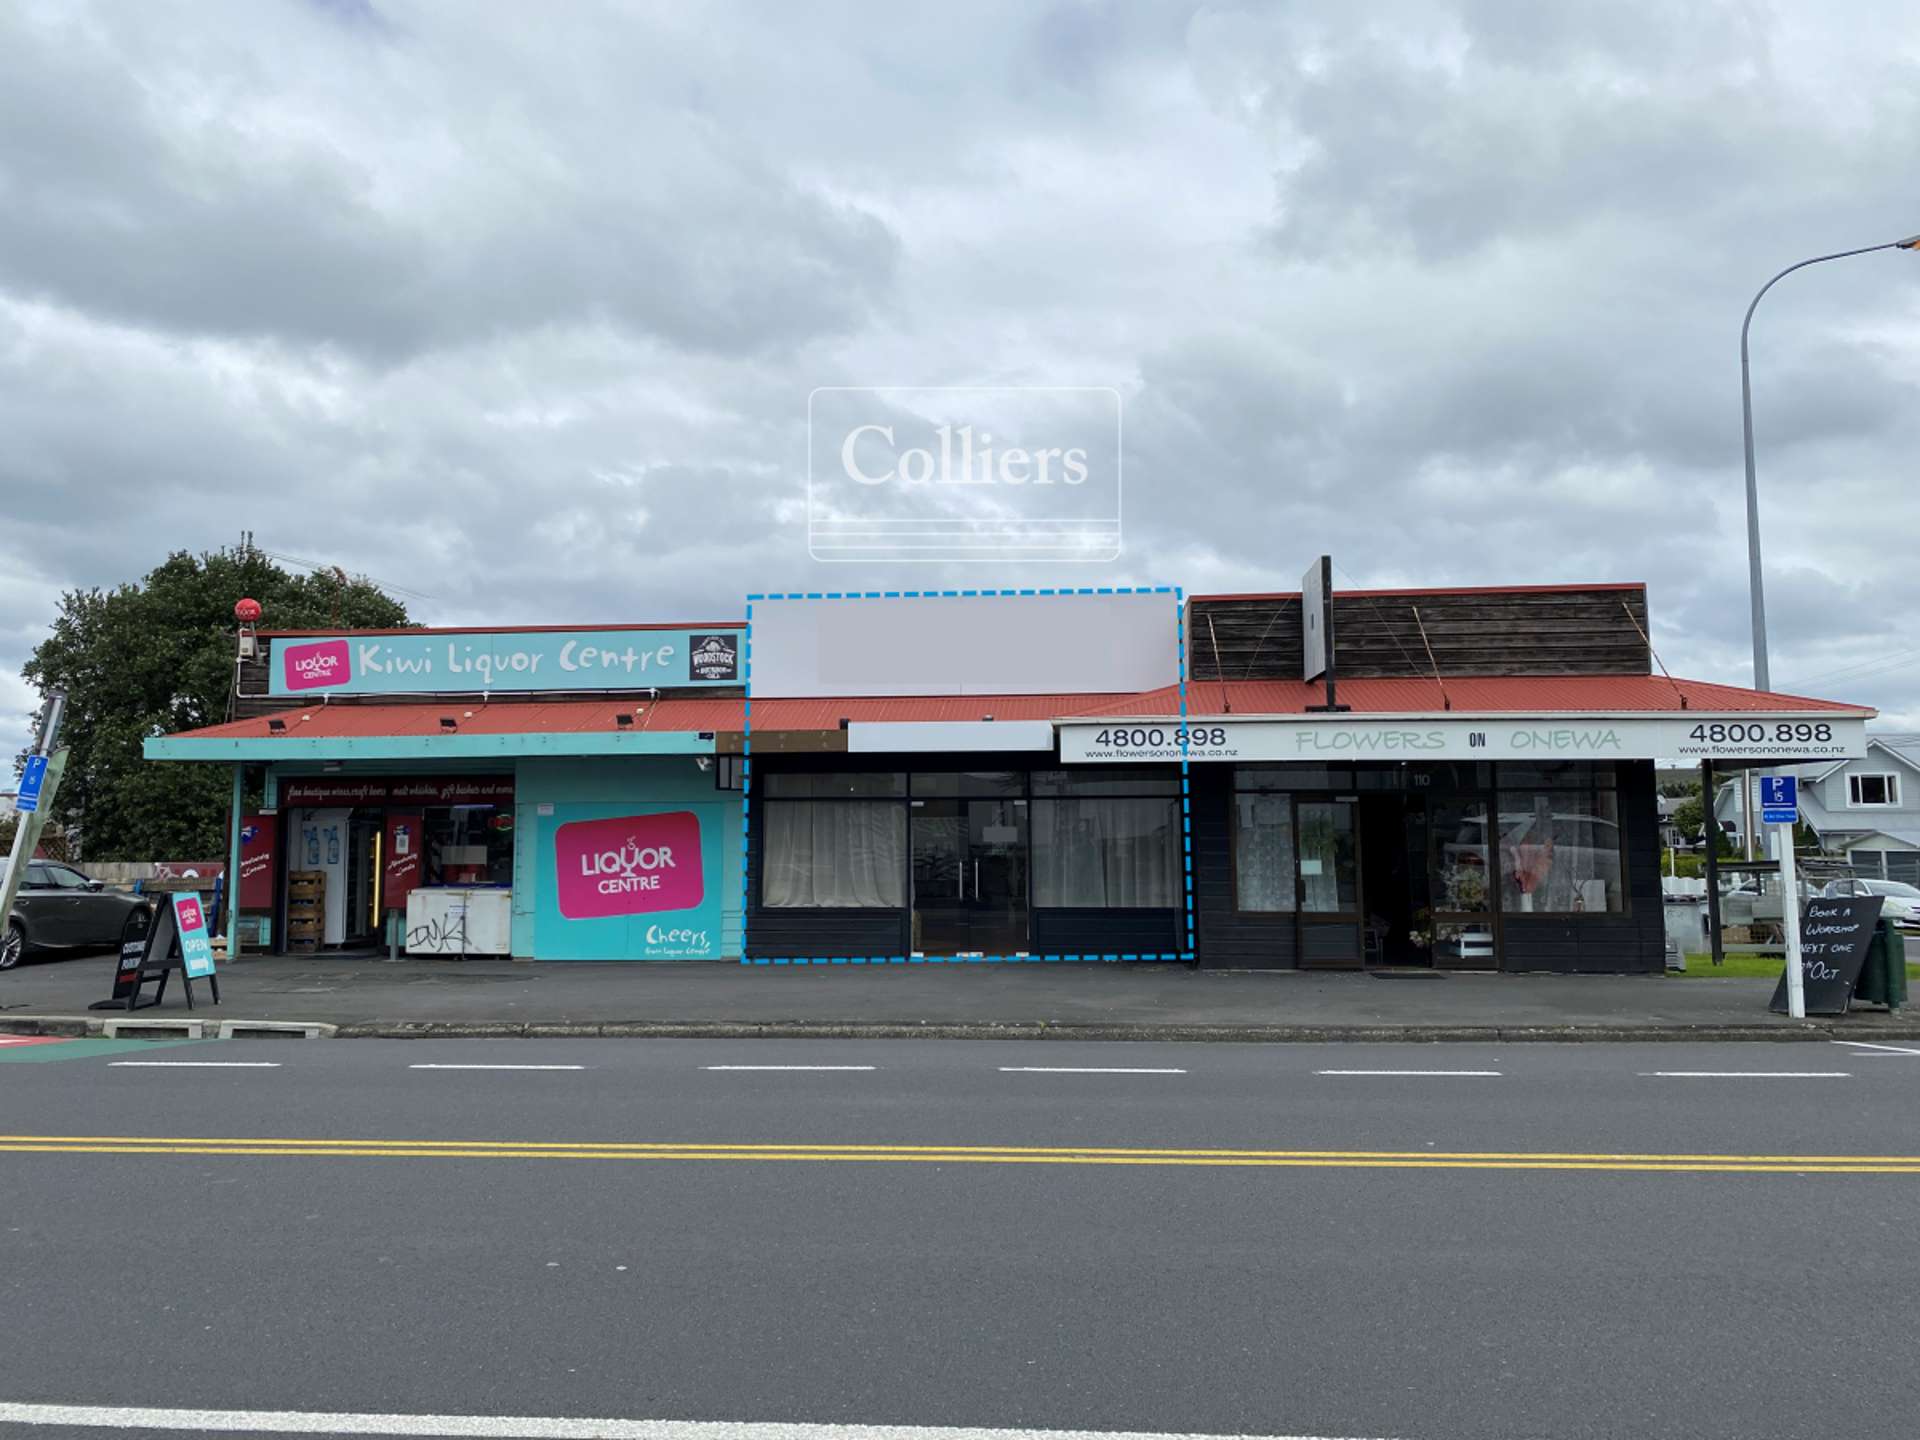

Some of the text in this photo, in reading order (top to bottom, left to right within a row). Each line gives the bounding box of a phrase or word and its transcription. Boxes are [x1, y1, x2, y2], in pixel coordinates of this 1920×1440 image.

[295, 653, 339, 672] LIQUOR
[359, 639, 674, 684] Kiwi Liquor Centre
[1095, 727, 1227, 748] 4800.898
[1296, 729, 1622, 750] FLOWERS ON ONEWA
[1689, 723, 1833, 743] 4800.898
[1084, 749, 1239, 759] www.flowersononwa.co.nz
[1678, 744, 1847, 755] www.flowersononewa.co.nz
[1772, 778, 1784, 791] P
[581, 847, 677, 877] LIQUOR
[597, 875, 661, 894] CENTRE
